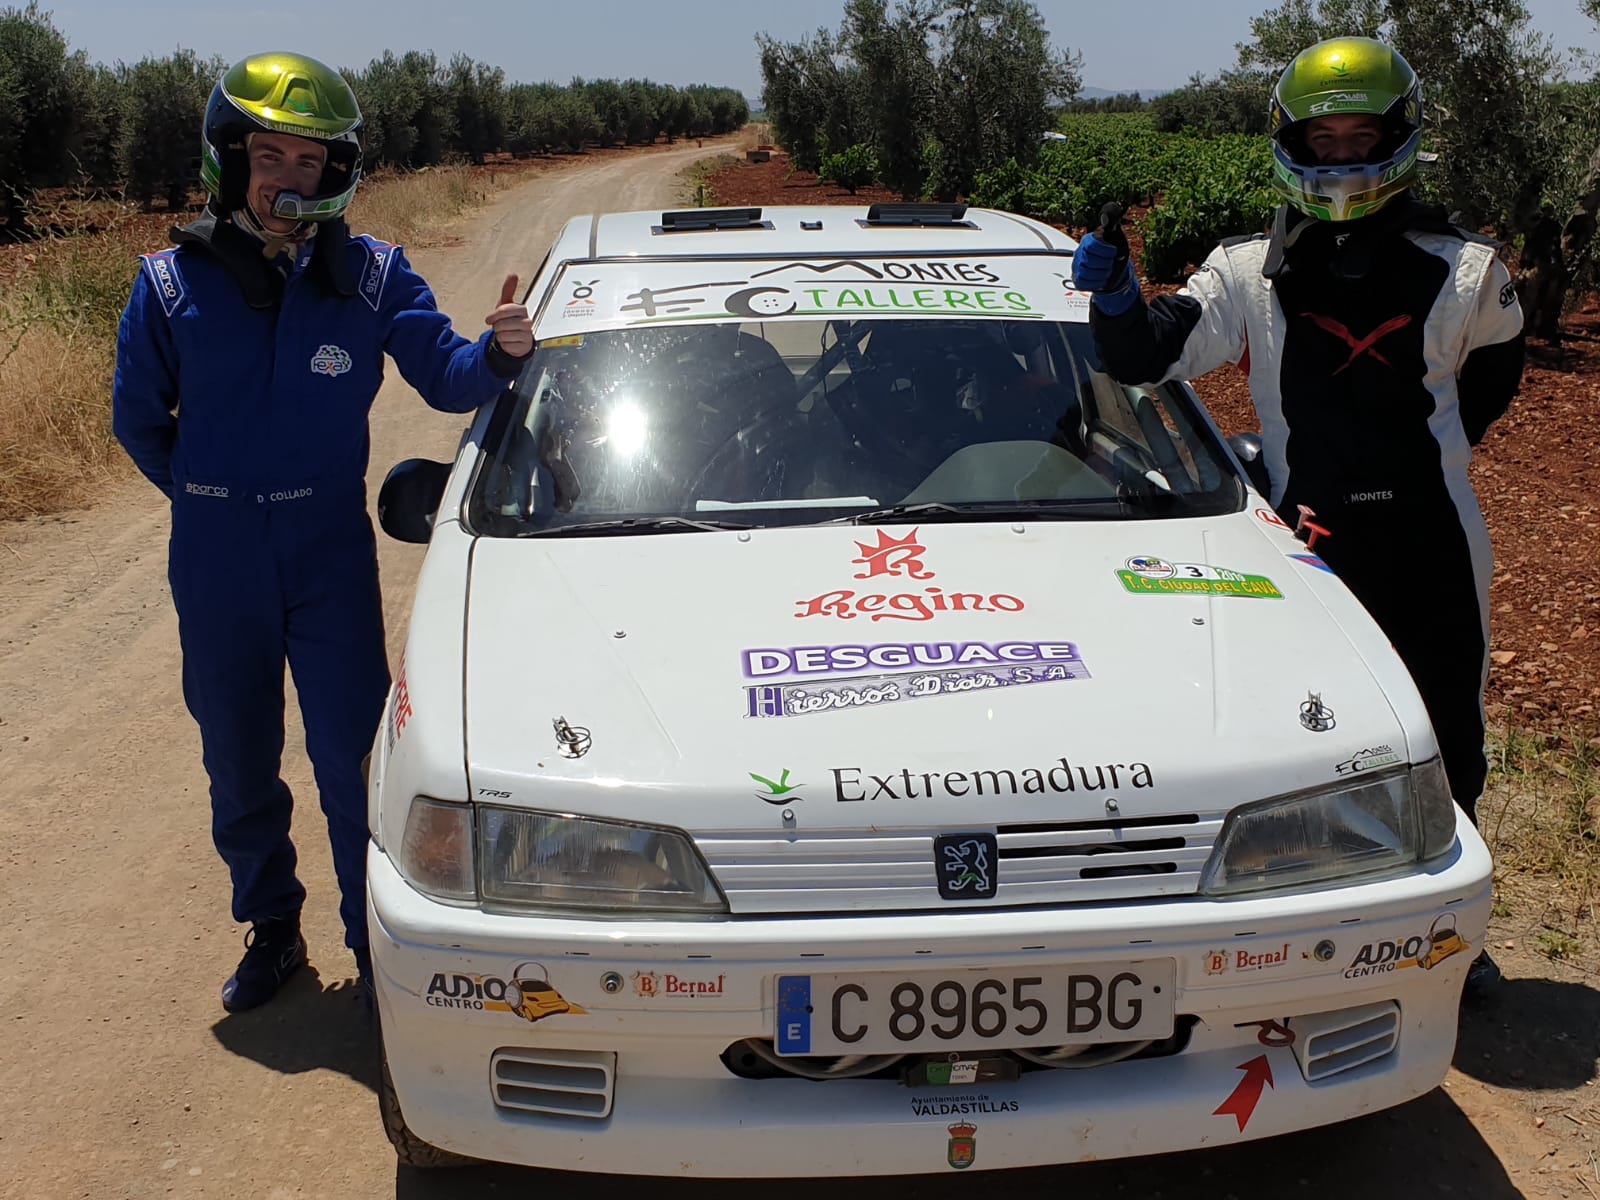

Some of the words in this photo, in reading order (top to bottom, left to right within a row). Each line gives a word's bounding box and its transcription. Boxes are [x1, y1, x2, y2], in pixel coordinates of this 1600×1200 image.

[155, 259, 176, 298] sparco
[366, 252, 386, 294] sparco
[750, 260, 1000, 283] MONTES
[803, 288, 1033, 312] TALLERES
[186, 482, 229, 498] sparco
[270, 487, 313, 502] COLLADO
[1351, 490, 1393, 503] MONTES
[1184, 566, 1204, 578] 3
[1158, 579, 1210, 593] CIUDAD
[1214, 581, 1241, 593] DEL
[1242, 581, 1281, 595] CAVA
[794, 587, 1025, 622] Regino
[747, 643, 1075, 678] DESGUACE
[742, 680, 902, 719] Hierros
[829, 757, 1154, 803] Extremadura
[479, 788, 513, 799] TRS
[1211, 955, 1222, 971] B
[1235, 943, 1289, 969] Bernal
[1344, 962, 1396, 979] CENTRO
[641, 976, 653, 992] B
[664, 974, 725, 993] Bernal
[426, 996, 483, 1010] CENTRO
[831, 983, 869, 1043] C
[888, 976, 1048, 1042] 8965
[1066, 972, 1143, 1034] BG
[787, 1023, 802, 1040] E
[911, 1095, 976, 1105] Ayuntamiento
[977, 1094, 990, 1102] de
[912, 1100, 1020, 1117] VALDASTILLAS
